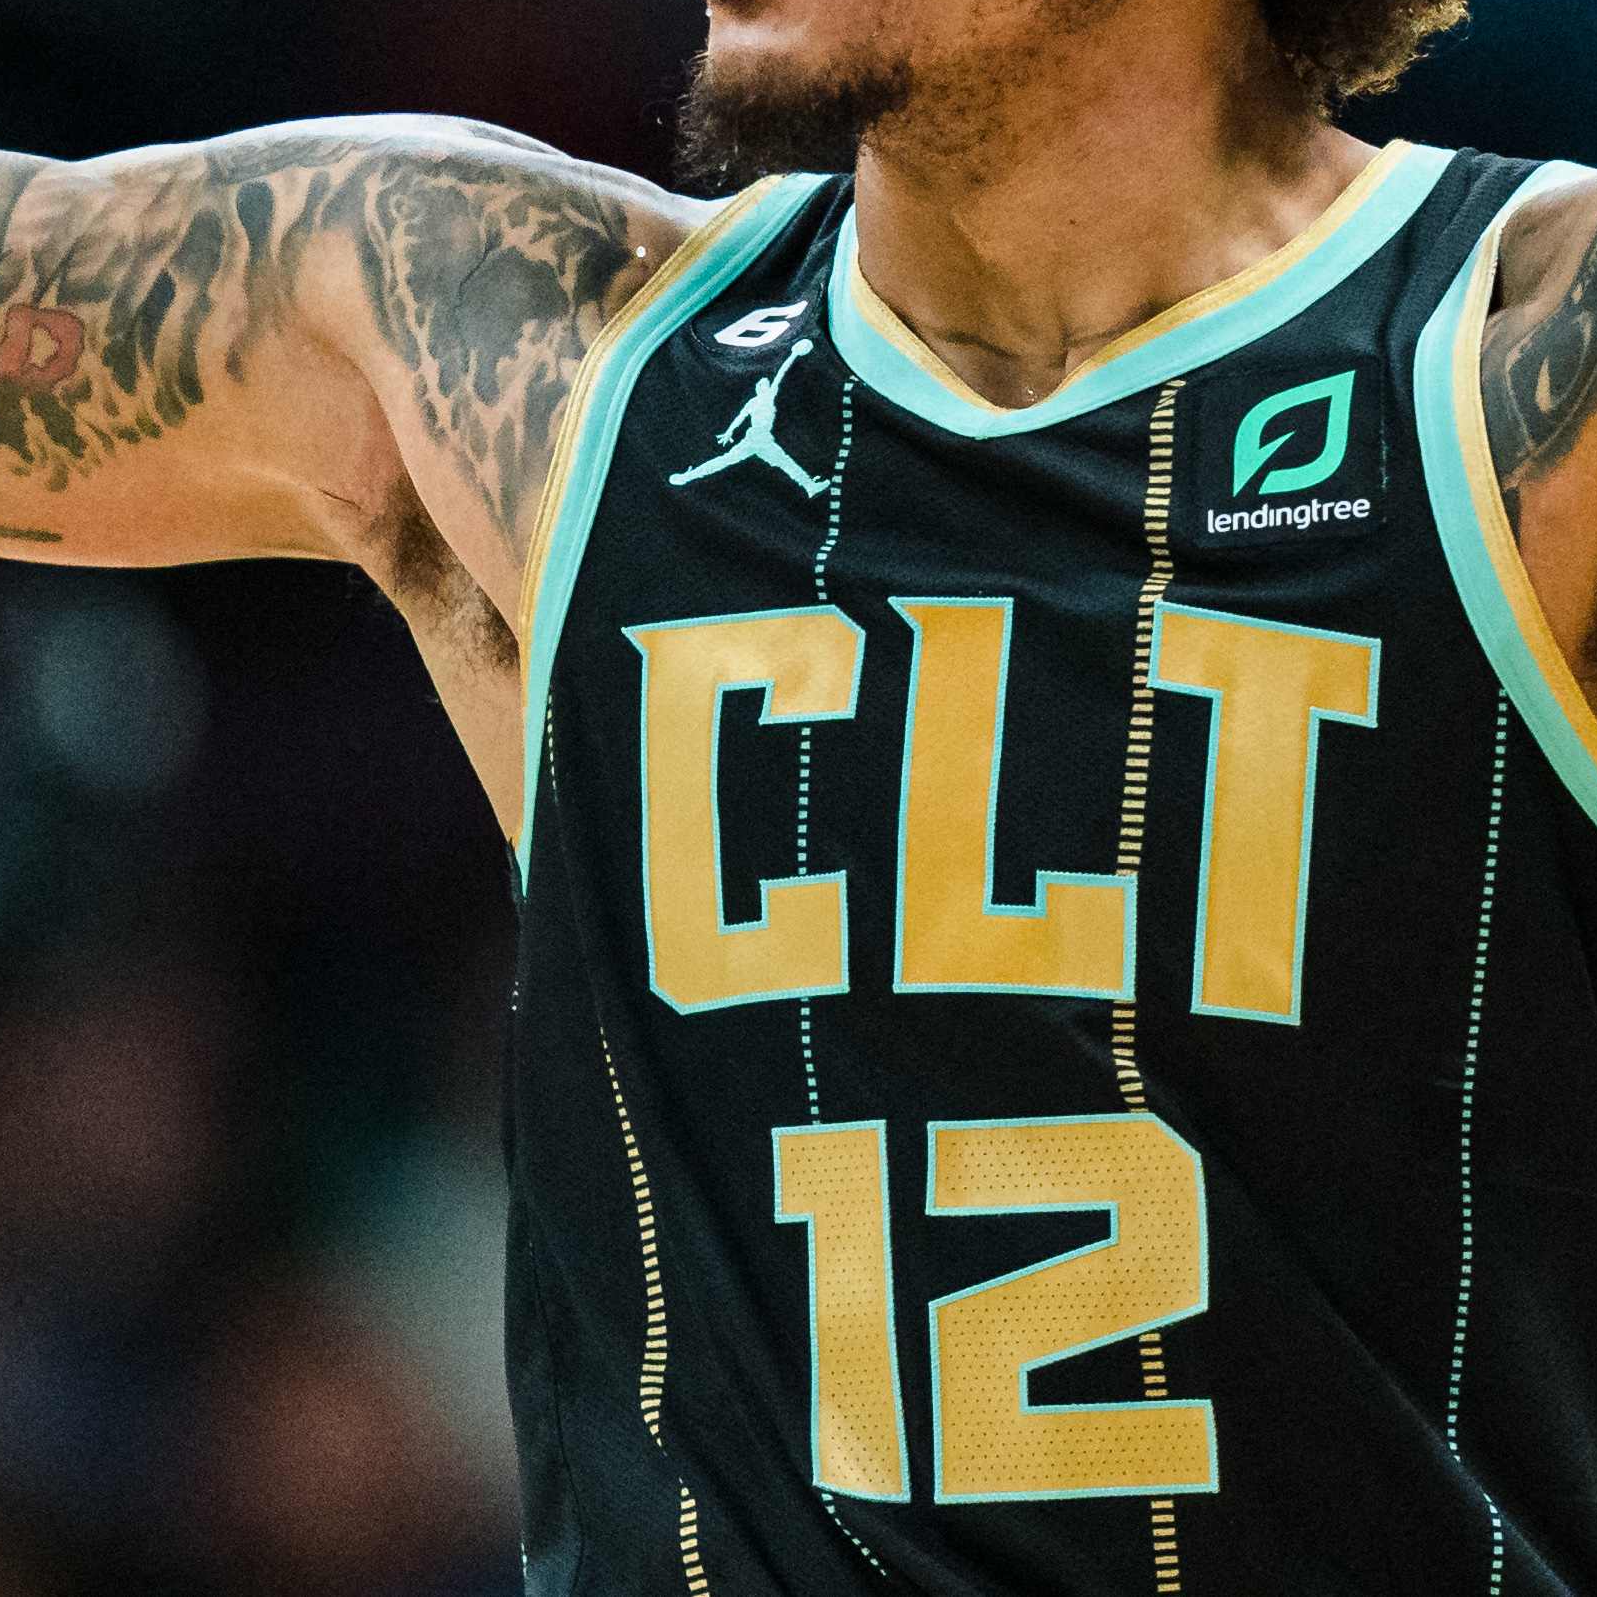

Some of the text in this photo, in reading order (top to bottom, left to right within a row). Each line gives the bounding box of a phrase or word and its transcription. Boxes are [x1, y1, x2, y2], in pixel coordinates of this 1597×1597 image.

[713, 300, 808, 348] 6
[1206, 497, 1372, 534] lendingtree
[621, 595, 1383, 1025] CLT
[771, 1112, 1219, 1505] 12
